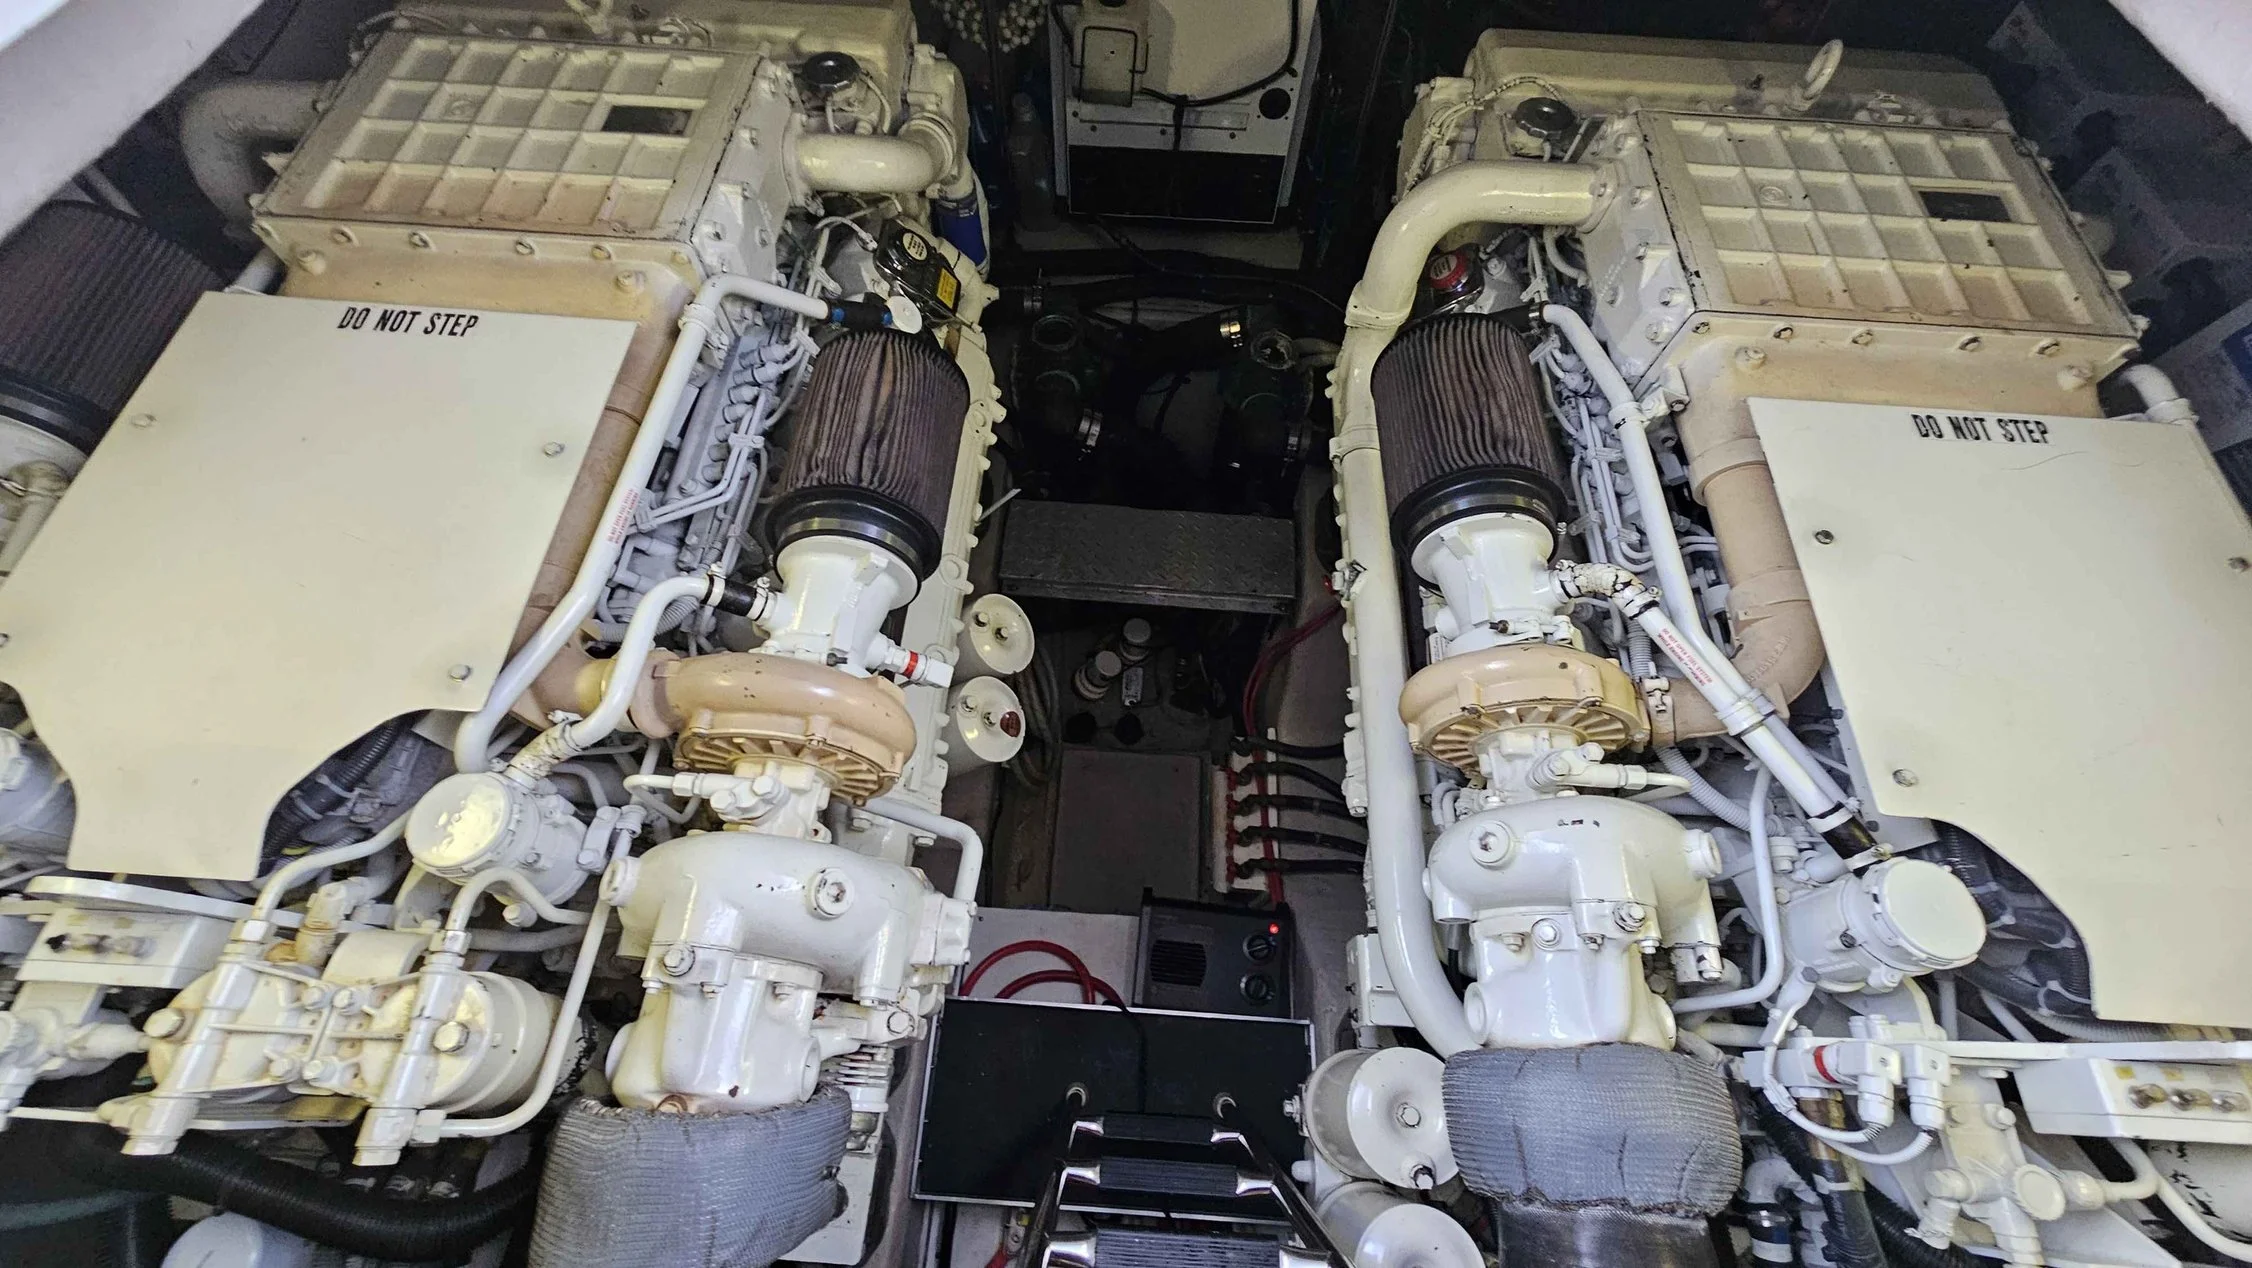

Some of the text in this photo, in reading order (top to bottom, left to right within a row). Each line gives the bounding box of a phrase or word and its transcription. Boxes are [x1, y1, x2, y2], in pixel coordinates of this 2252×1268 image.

[337, 307, 479, 337] DO NOT STEP
[1911, 414, 2049, 444] DO NOT STEP
